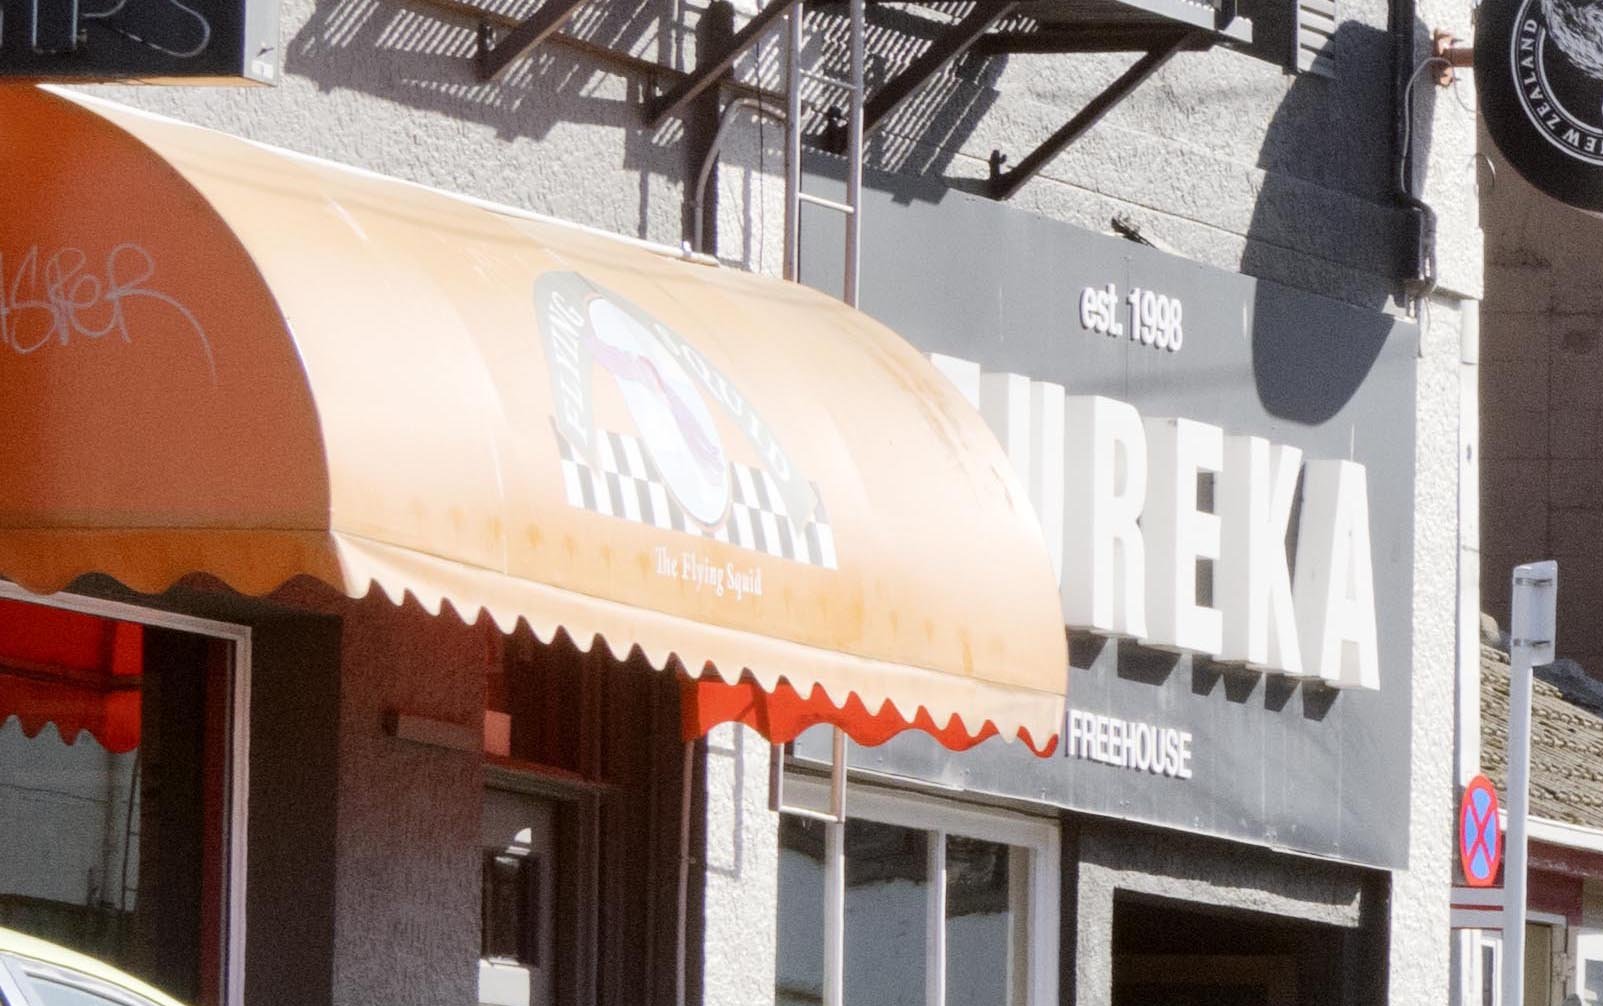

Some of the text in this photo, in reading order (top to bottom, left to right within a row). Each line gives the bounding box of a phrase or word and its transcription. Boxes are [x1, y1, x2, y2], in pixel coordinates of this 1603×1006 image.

[1520, 18, 1561, 129] ZEALAND
[1080, 284, 1184, 353] est. 1998
[655, 546, 763, 600] The Flying Squid
[1066, 708, 1193, 779] FREEHOUSE
